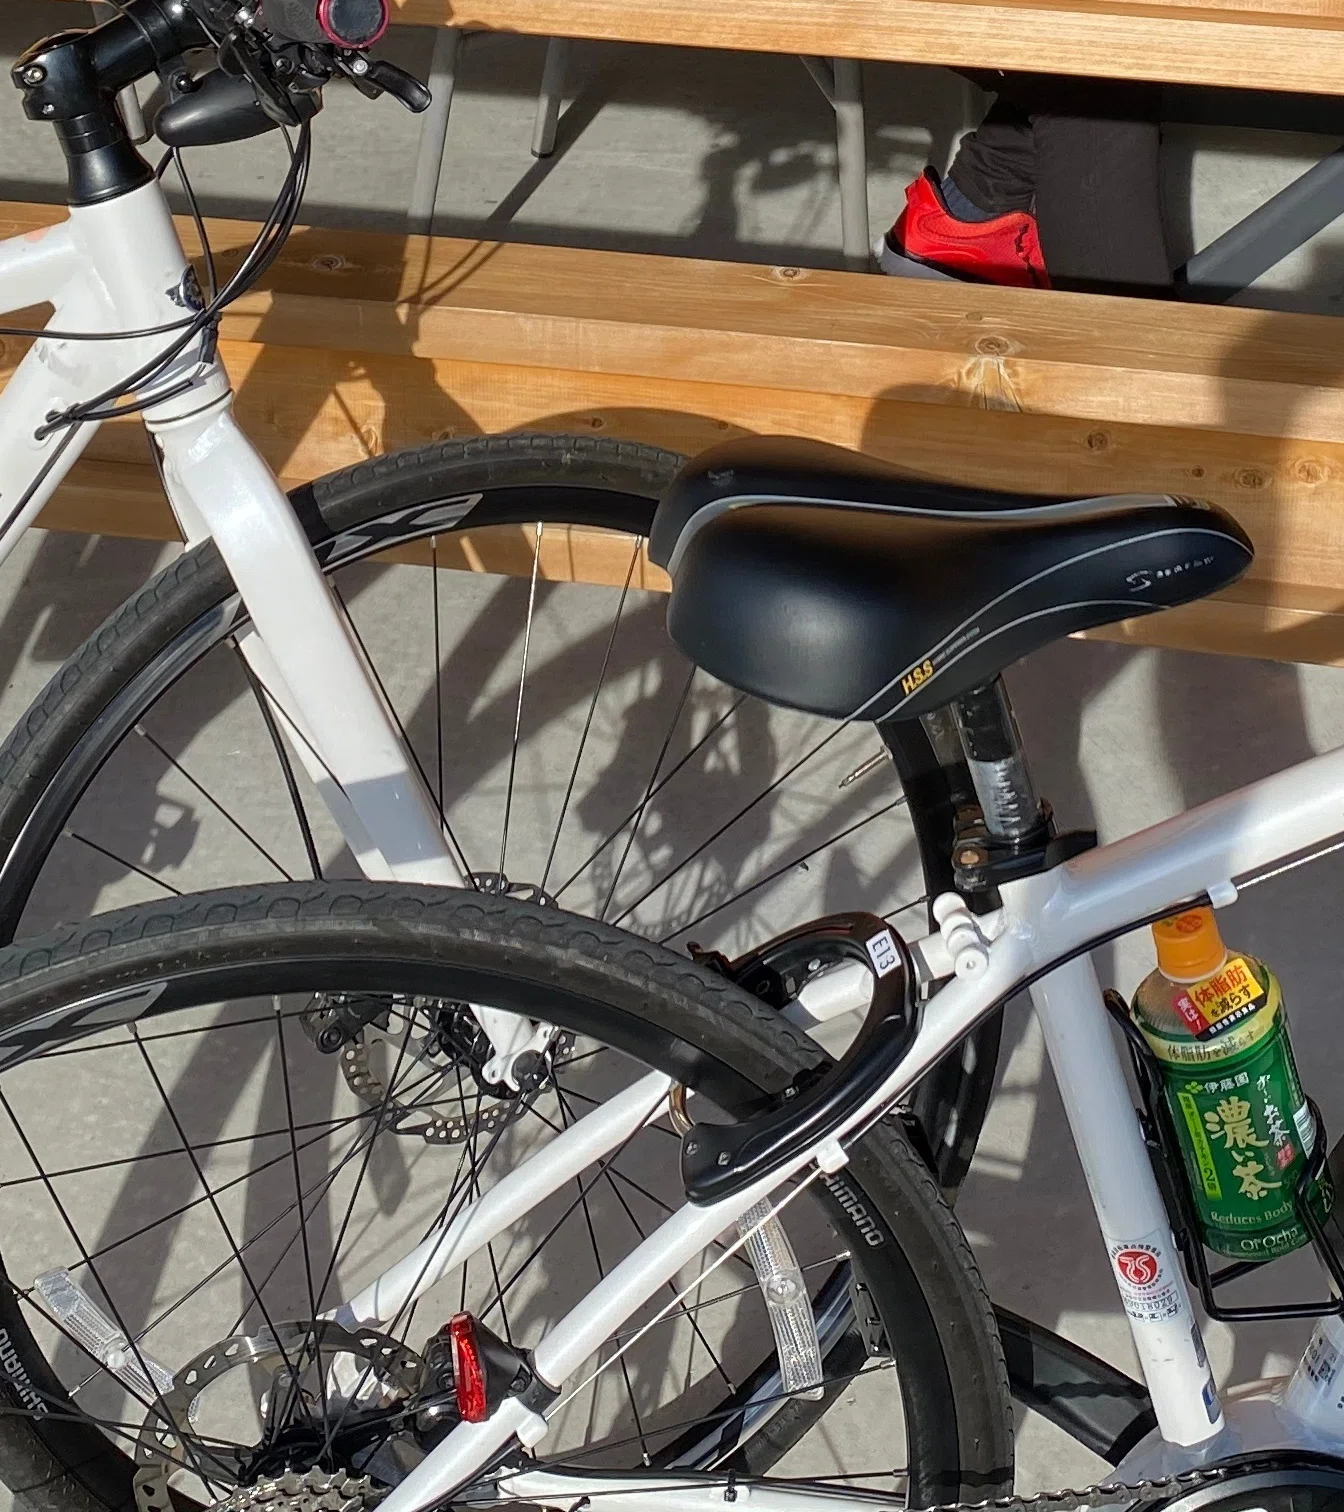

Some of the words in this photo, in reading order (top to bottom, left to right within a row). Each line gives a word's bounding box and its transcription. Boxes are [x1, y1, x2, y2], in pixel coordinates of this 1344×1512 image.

[872, 936, 896, 970] E13
[1194, 964, 1248, 1009] 体脂肪
